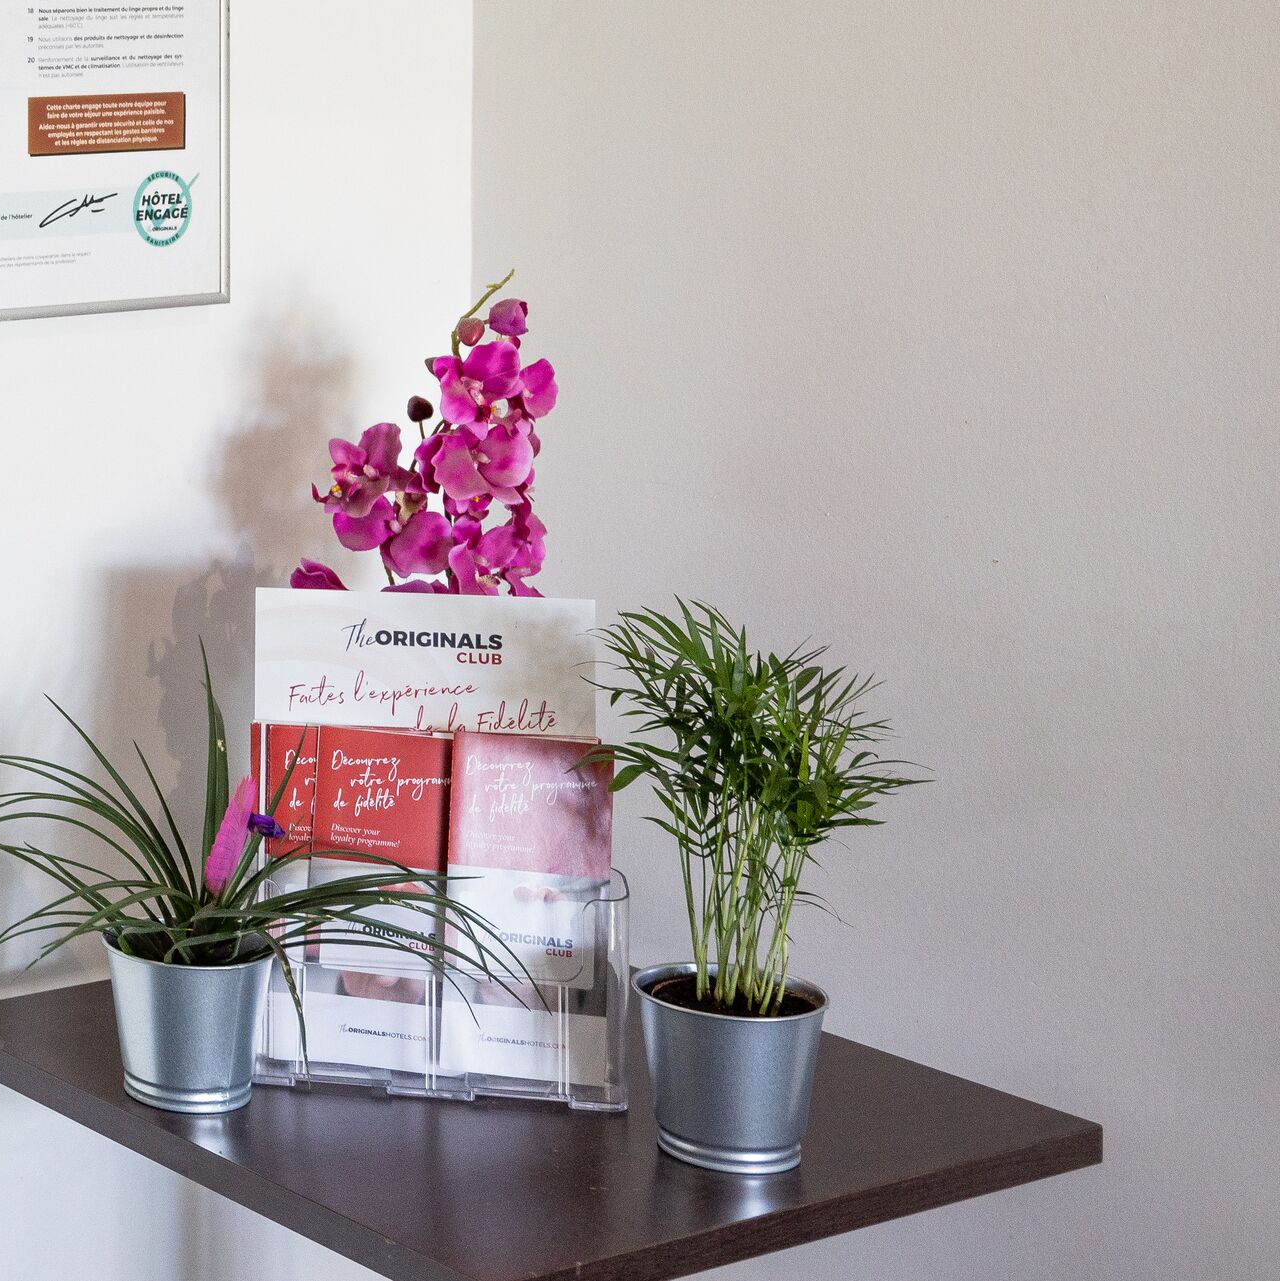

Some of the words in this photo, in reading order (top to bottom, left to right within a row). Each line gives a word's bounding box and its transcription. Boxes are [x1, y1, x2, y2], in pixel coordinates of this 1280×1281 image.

[142, 190, 182, 206] HÔTEL
[136, 204, 188, 221] ENGAGÉ
[375, 630, 502, 650] ORIGINALS
[456, 652, 502, 665] CLUB
[289, 675, 345, 711] Faites
[354, 670, 477, 716] l'expérience
[477, 698, 557, 732] Fidélité
[332, 749, 400, 781] Découvrez
[351, 766, 384, 787] votre
[334, 788, 347, 810] de
[355, 788, 395, 816] fidélité
[331, 824, 362, 834] Discover
[330, 832, 356, 844] loyalty
[356, 836, 400, 848] programme!
[408, 942, 435, 952] CLUB
[546, 948, 572, 958] CLUB
